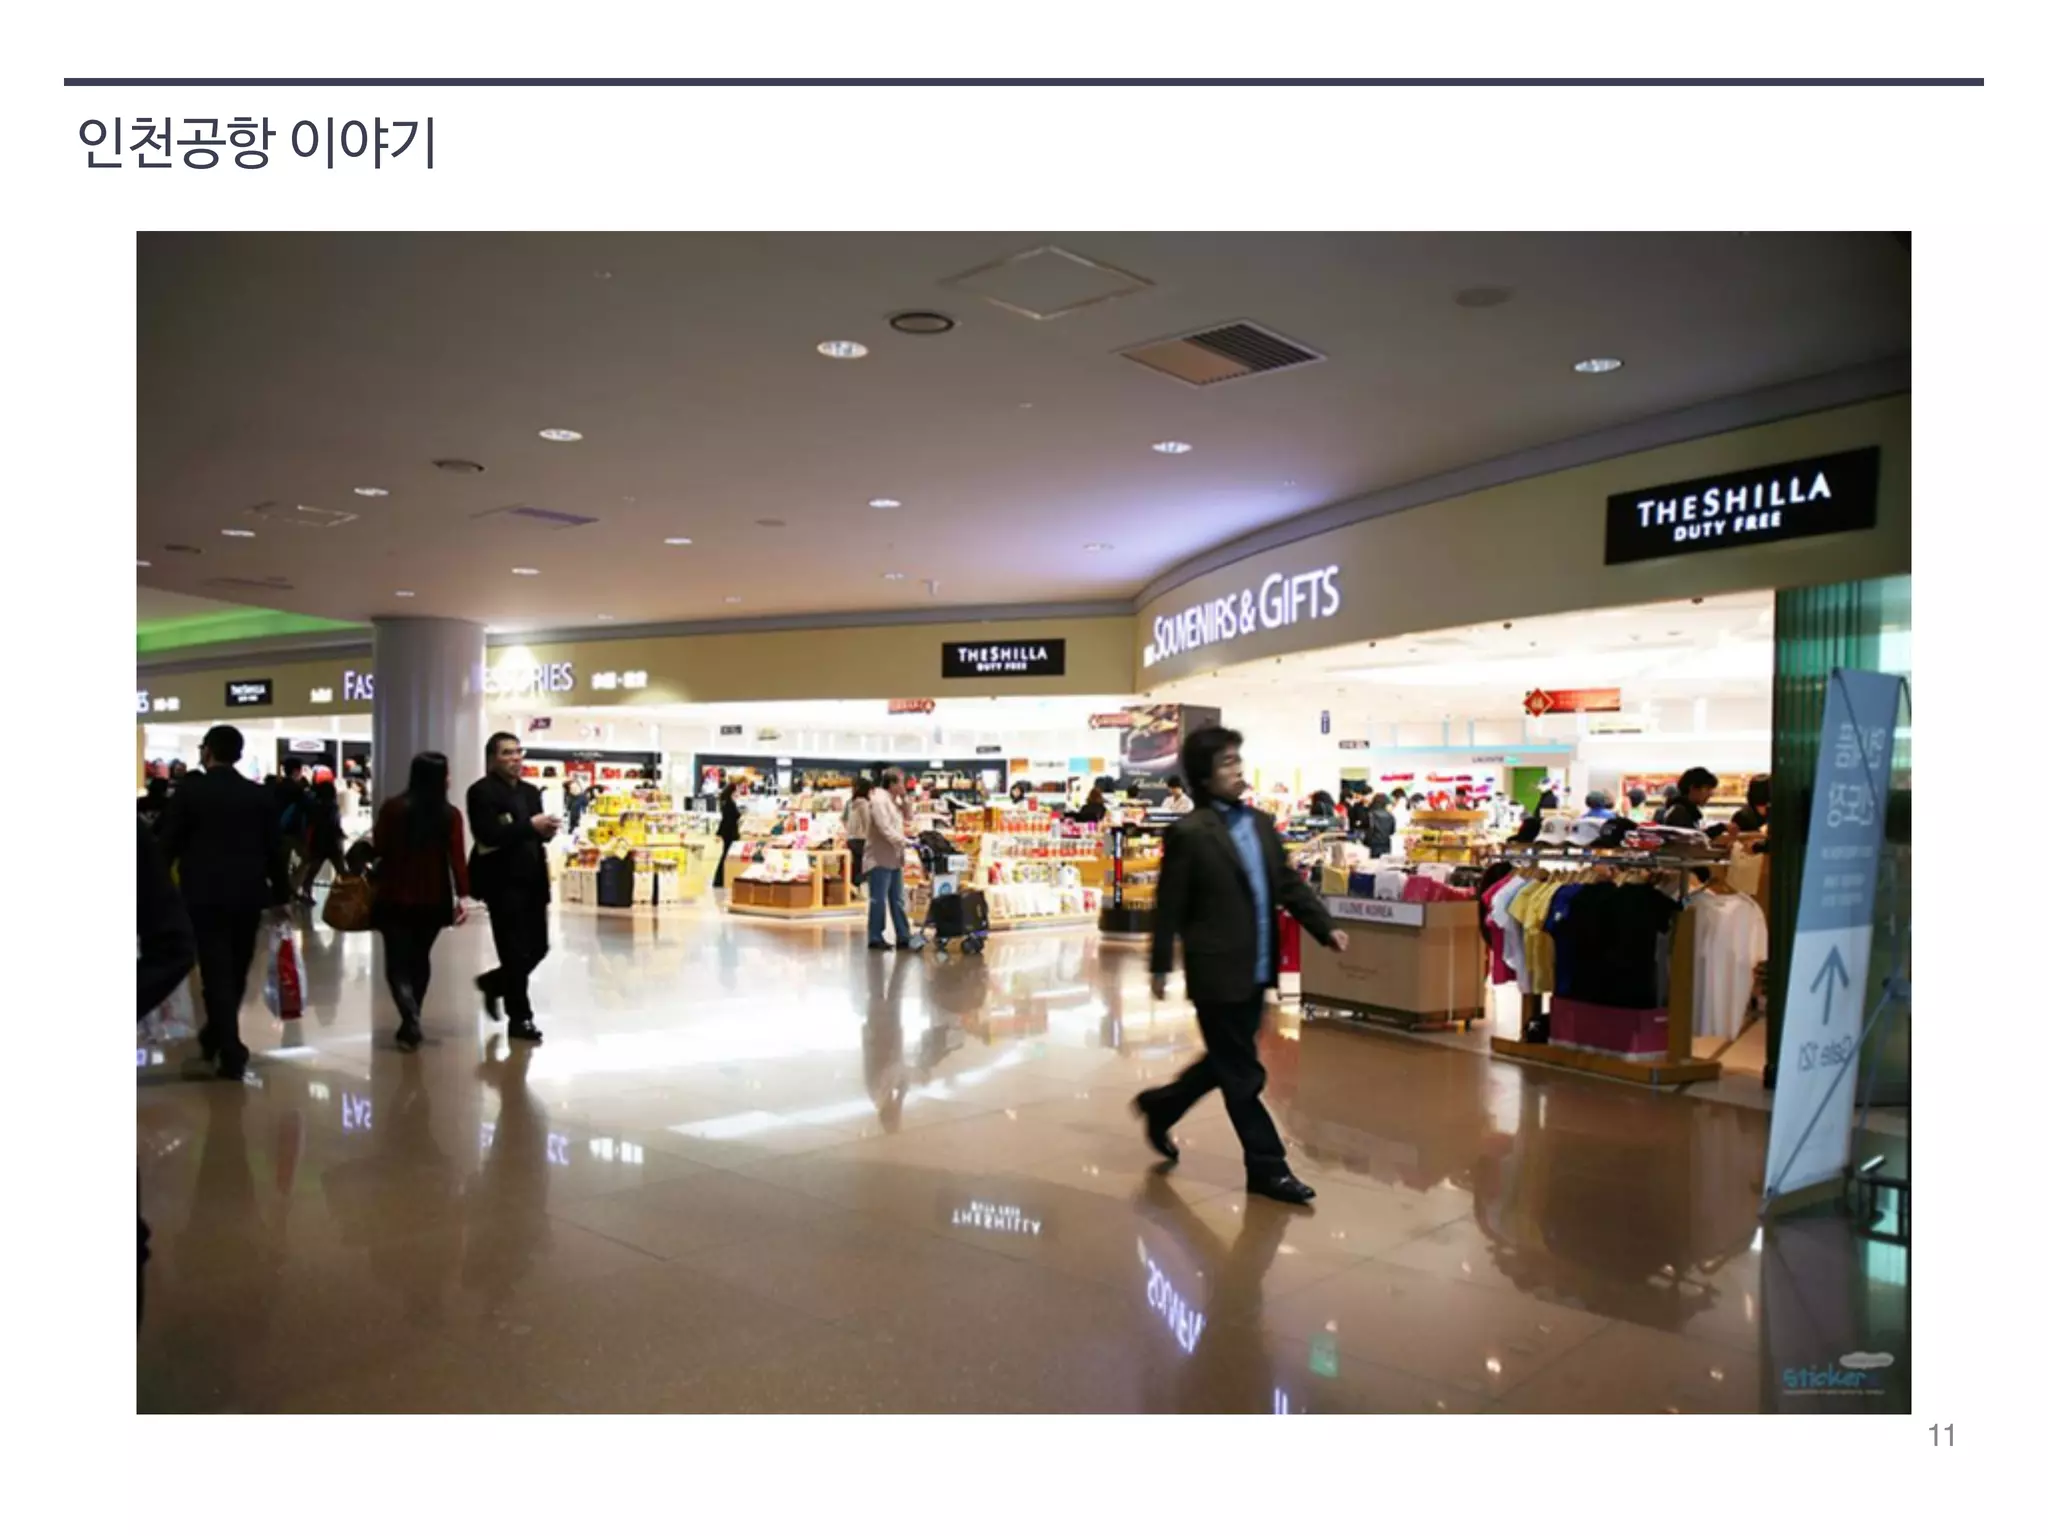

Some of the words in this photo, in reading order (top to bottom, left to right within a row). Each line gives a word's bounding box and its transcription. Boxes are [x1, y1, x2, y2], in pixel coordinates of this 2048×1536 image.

[1673, 520, 1726, 542] DUTY
[1733, 510, 1782, 533] FREE
[1152, 592, 1238, 662] SOUVENIRS
[1239, 588, 1257, 635] &
[1258, 564, 1340, 629] GIFTS
[975, 662, 1003, 672] DUTY
[1003, 661, 1028, 671] FREE
